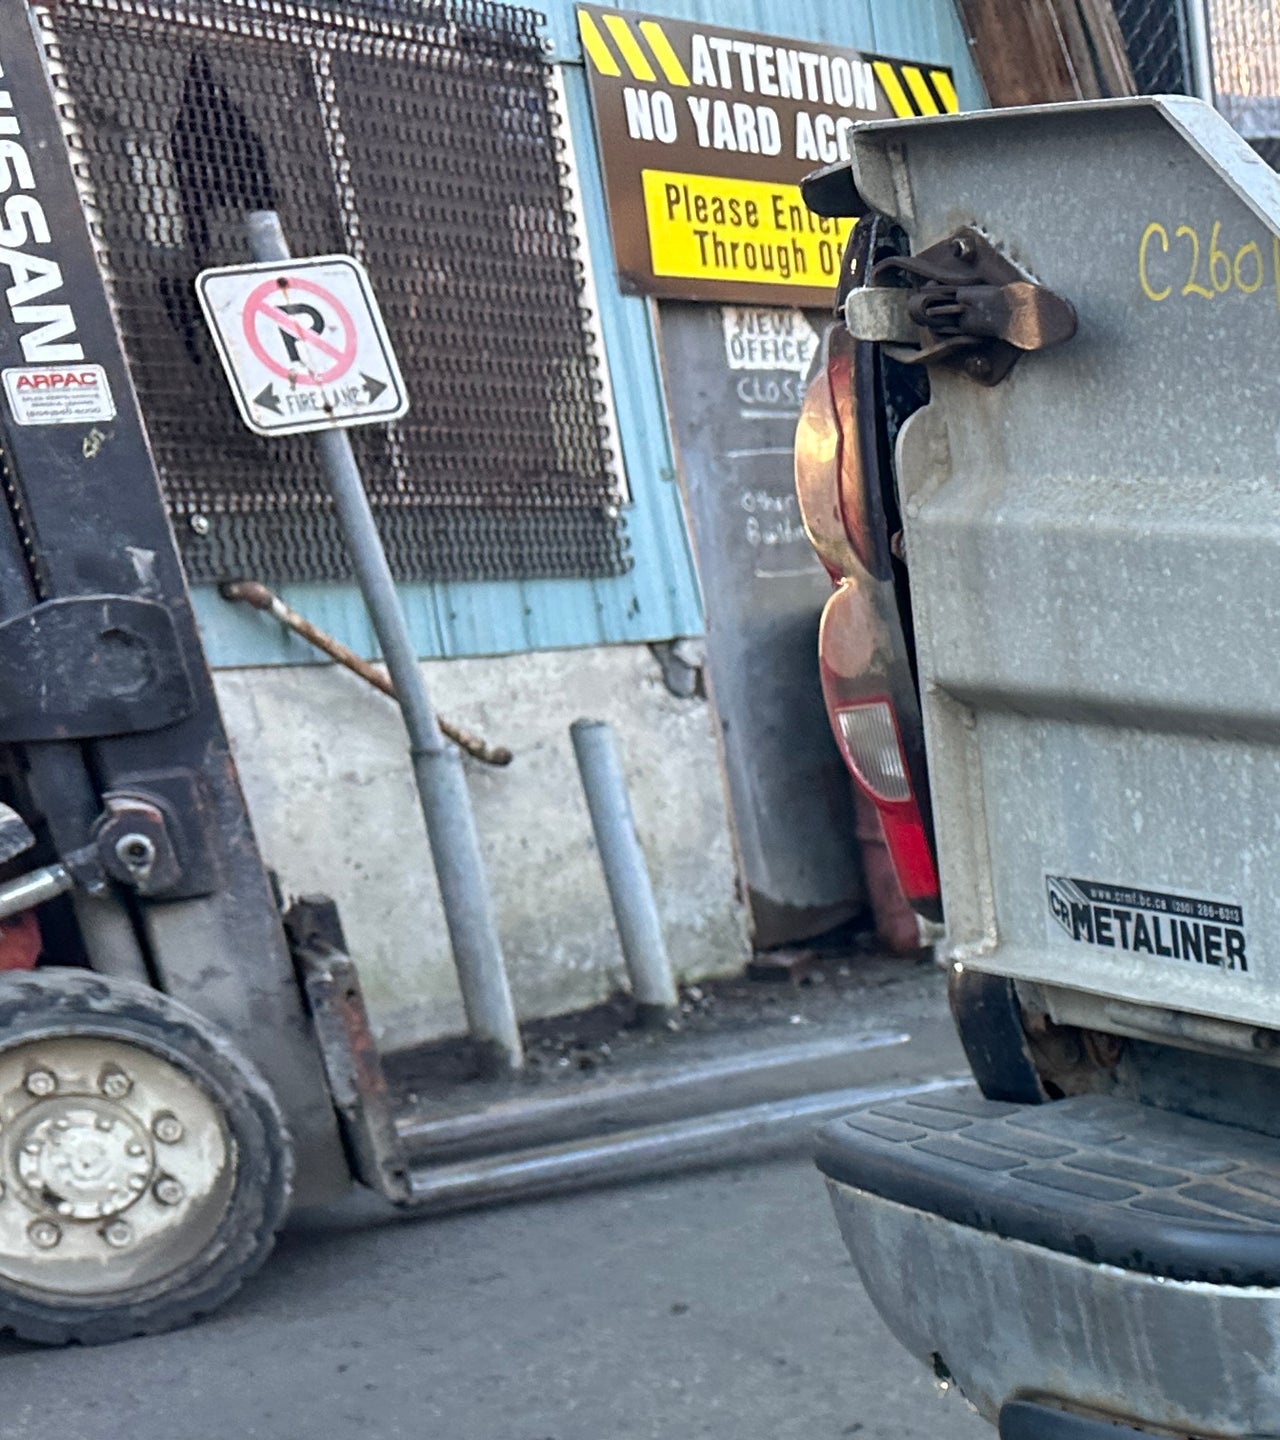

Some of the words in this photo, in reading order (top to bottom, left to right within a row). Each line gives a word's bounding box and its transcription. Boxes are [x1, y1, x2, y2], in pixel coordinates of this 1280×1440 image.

[691, 33, 877, 112] ATTENTION
[623, 87, 677, 144] NO
[687, 96, 782, 156] YARD
[0, 57, 85, 363] SSAN
[665, 183, 759, 228] Please
[771, 195, 840, 236] Enter
[693, 229, 808, 279] Through
[731, 334, 811, 364] OFFICE
[16, 372, 99, 390] ARPAC
[1050, 889, 1071, 931] CR
[1070, 900, 1249, 972] METALINER
